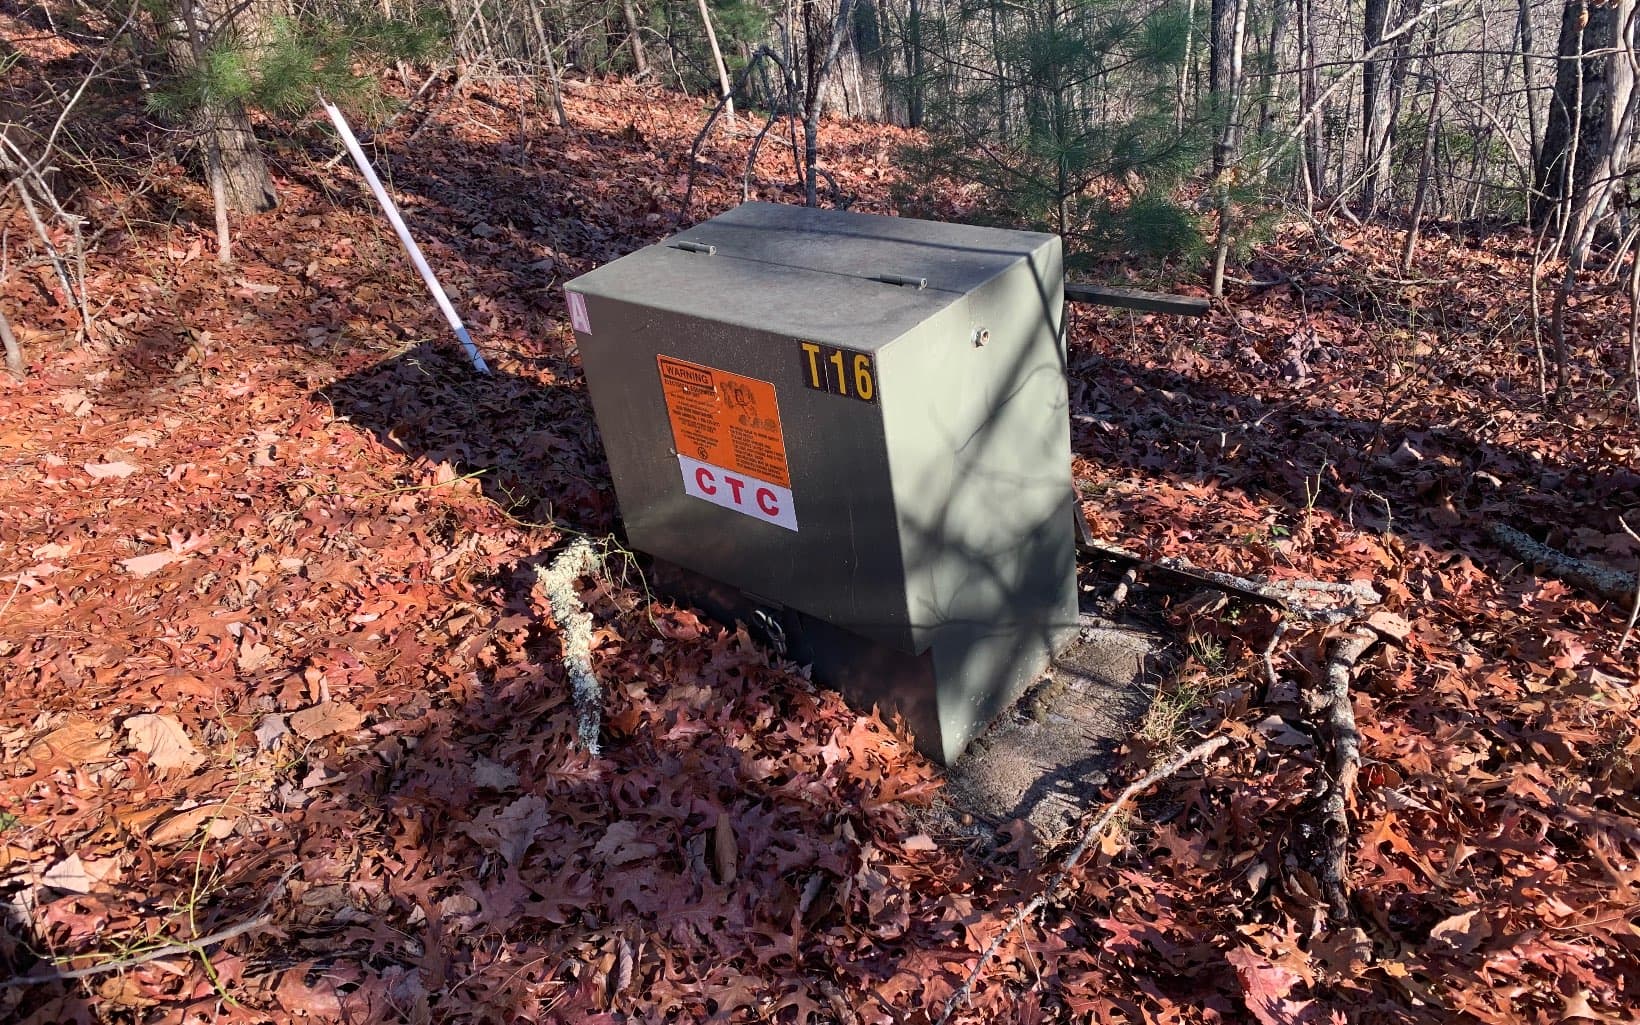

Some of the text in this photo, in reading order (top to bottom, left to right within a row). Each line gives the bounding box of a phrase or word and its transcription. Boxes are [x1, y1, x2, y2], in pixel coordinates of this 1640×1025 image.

[571, 293, 588, 331] A
[666, 365, 709, 385] WARNING
[802, 342, 873, 400] T16
[695, 467, 779, 517] CTC
